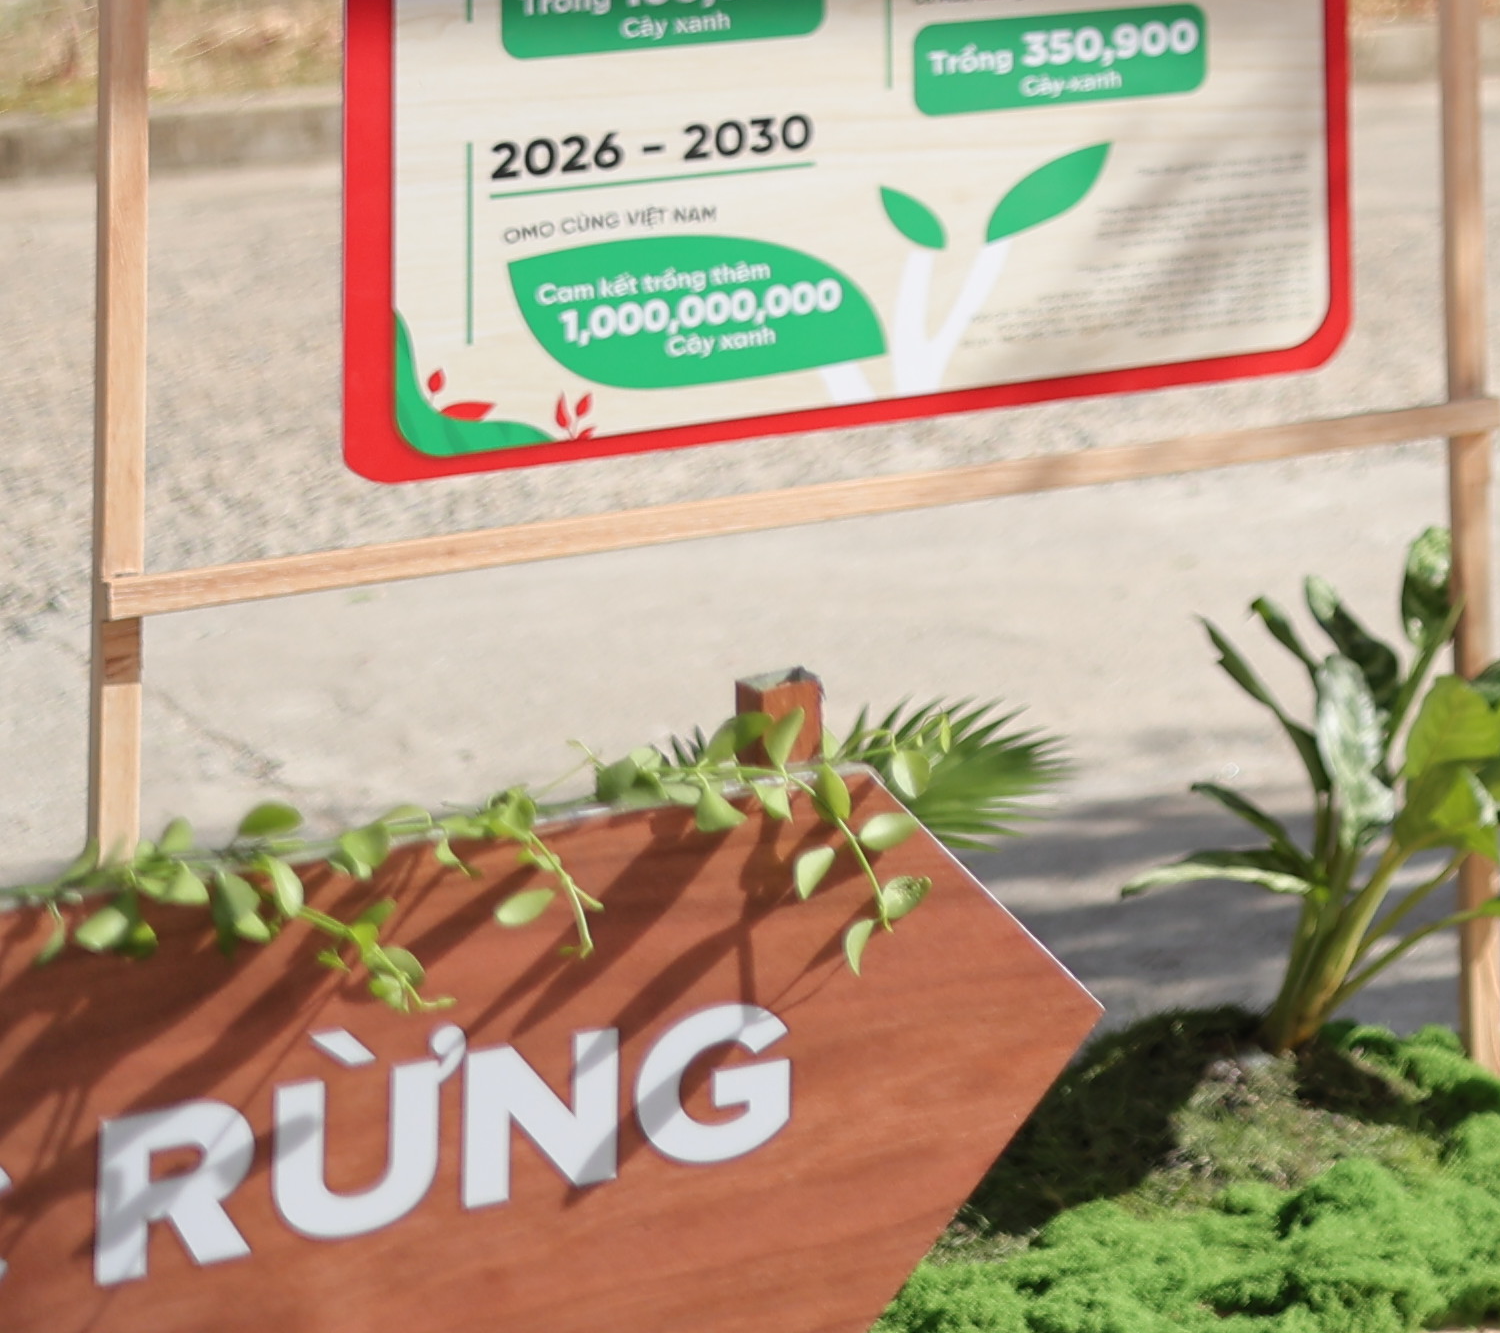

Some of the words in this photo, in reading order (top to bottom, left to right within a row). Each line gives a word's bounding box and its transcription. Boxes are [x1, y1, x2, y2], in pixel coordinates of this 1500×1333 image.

[620, 16, 668, 40] Cây
[672, 11, 731, 34] xanh
[1021, 19, 1199, 66] 350,900
[1019, 74, 1064, 100] Cây
[1067, 71, 1121, 92] xanh
[491, 131, 623, 181] 2026
[683, 113, 814, 161] 2030
[503, 221, 555, 245] OMO
[561, 210, 620, 235] CÙNG
[626, 204, 667, 230] VIỆT
[673, 205, 717, 223] NAM
[536, 281, 594, 306] Cam
[597, 272, 638, 299] kết
[710, 260, 771, 285] thêm
[558, 278, 842, 347] 1,000,000,000
[664, 335, 714, 359] Cây
[719, 327, 776, 350] xanh
[94, 1001, 793, 1286] RỪNG
